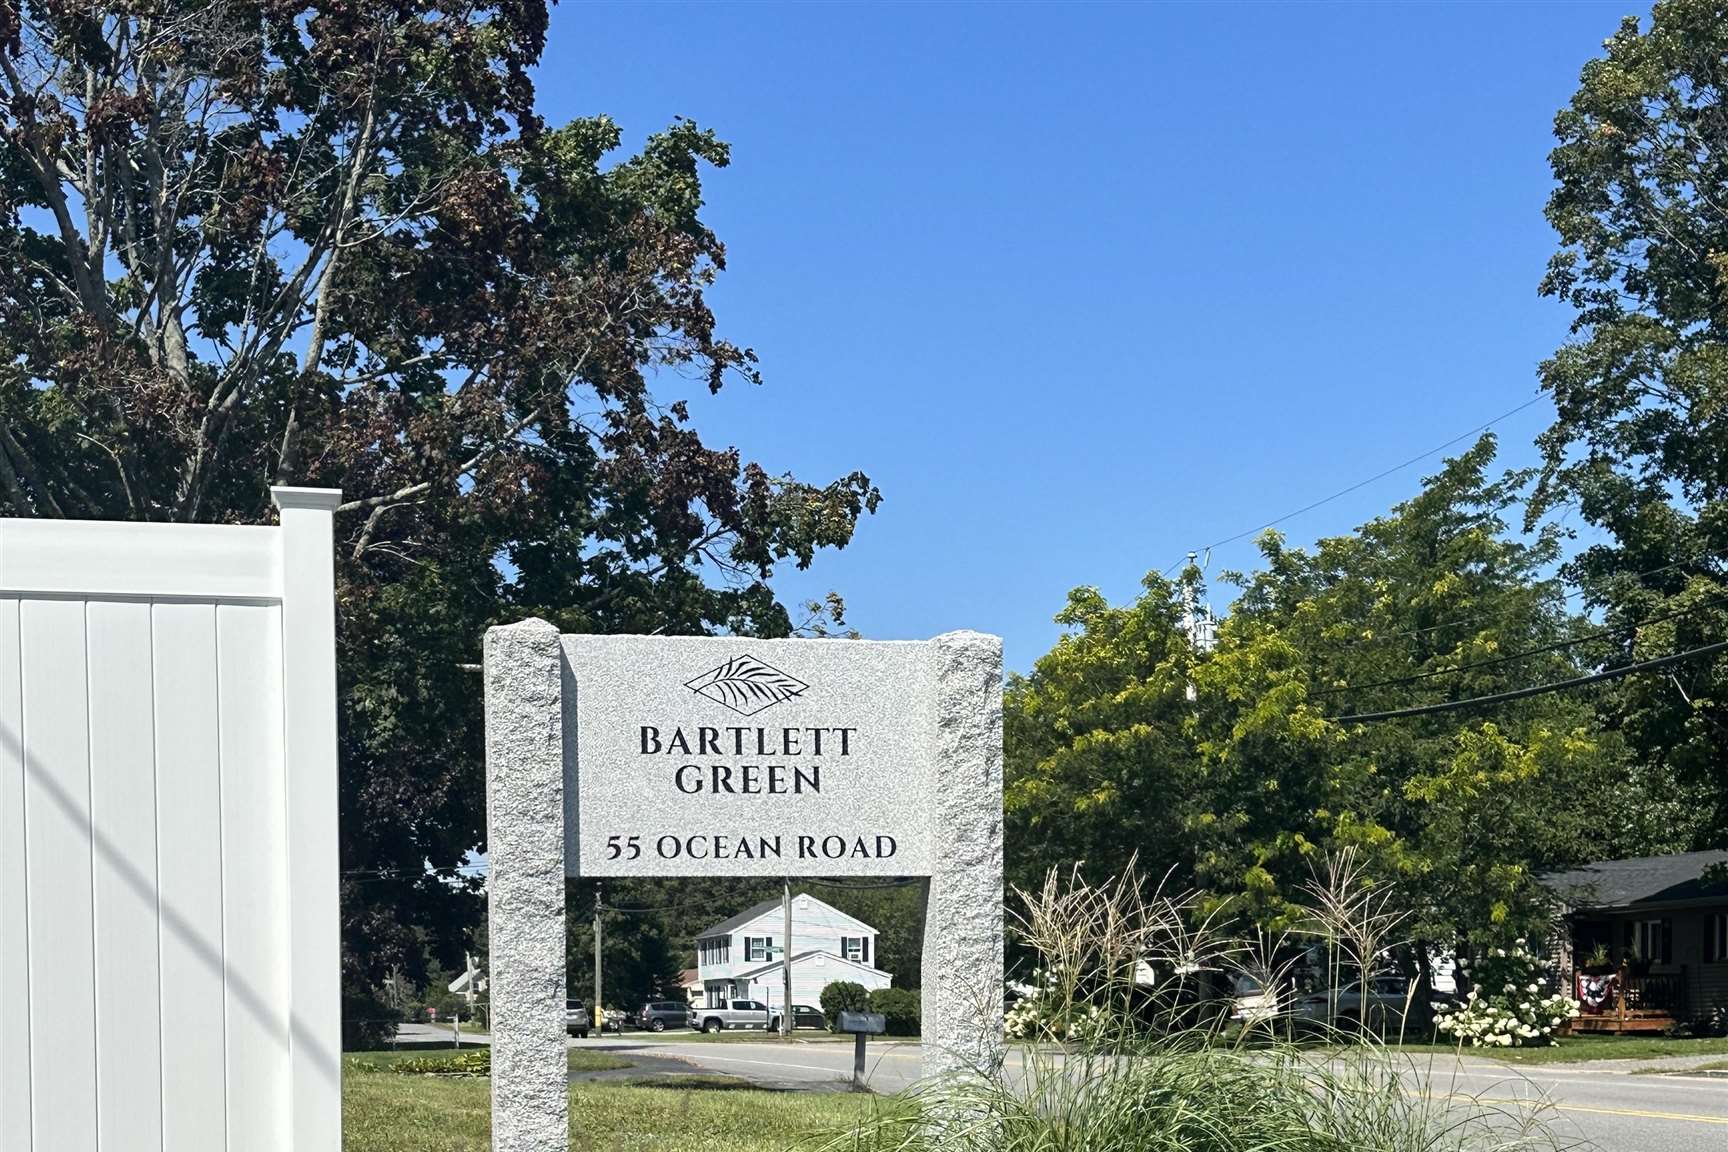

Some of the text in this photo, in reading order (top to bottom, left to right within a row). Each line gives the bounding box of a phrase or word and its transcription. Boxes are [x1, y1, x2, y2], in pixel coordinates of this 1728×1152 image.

[640, 726, 857, 756] BARTLETT
[674, 765, 822, 794] GREEN
[606, 835, 898, 860] 55 OCEAN ROAD
